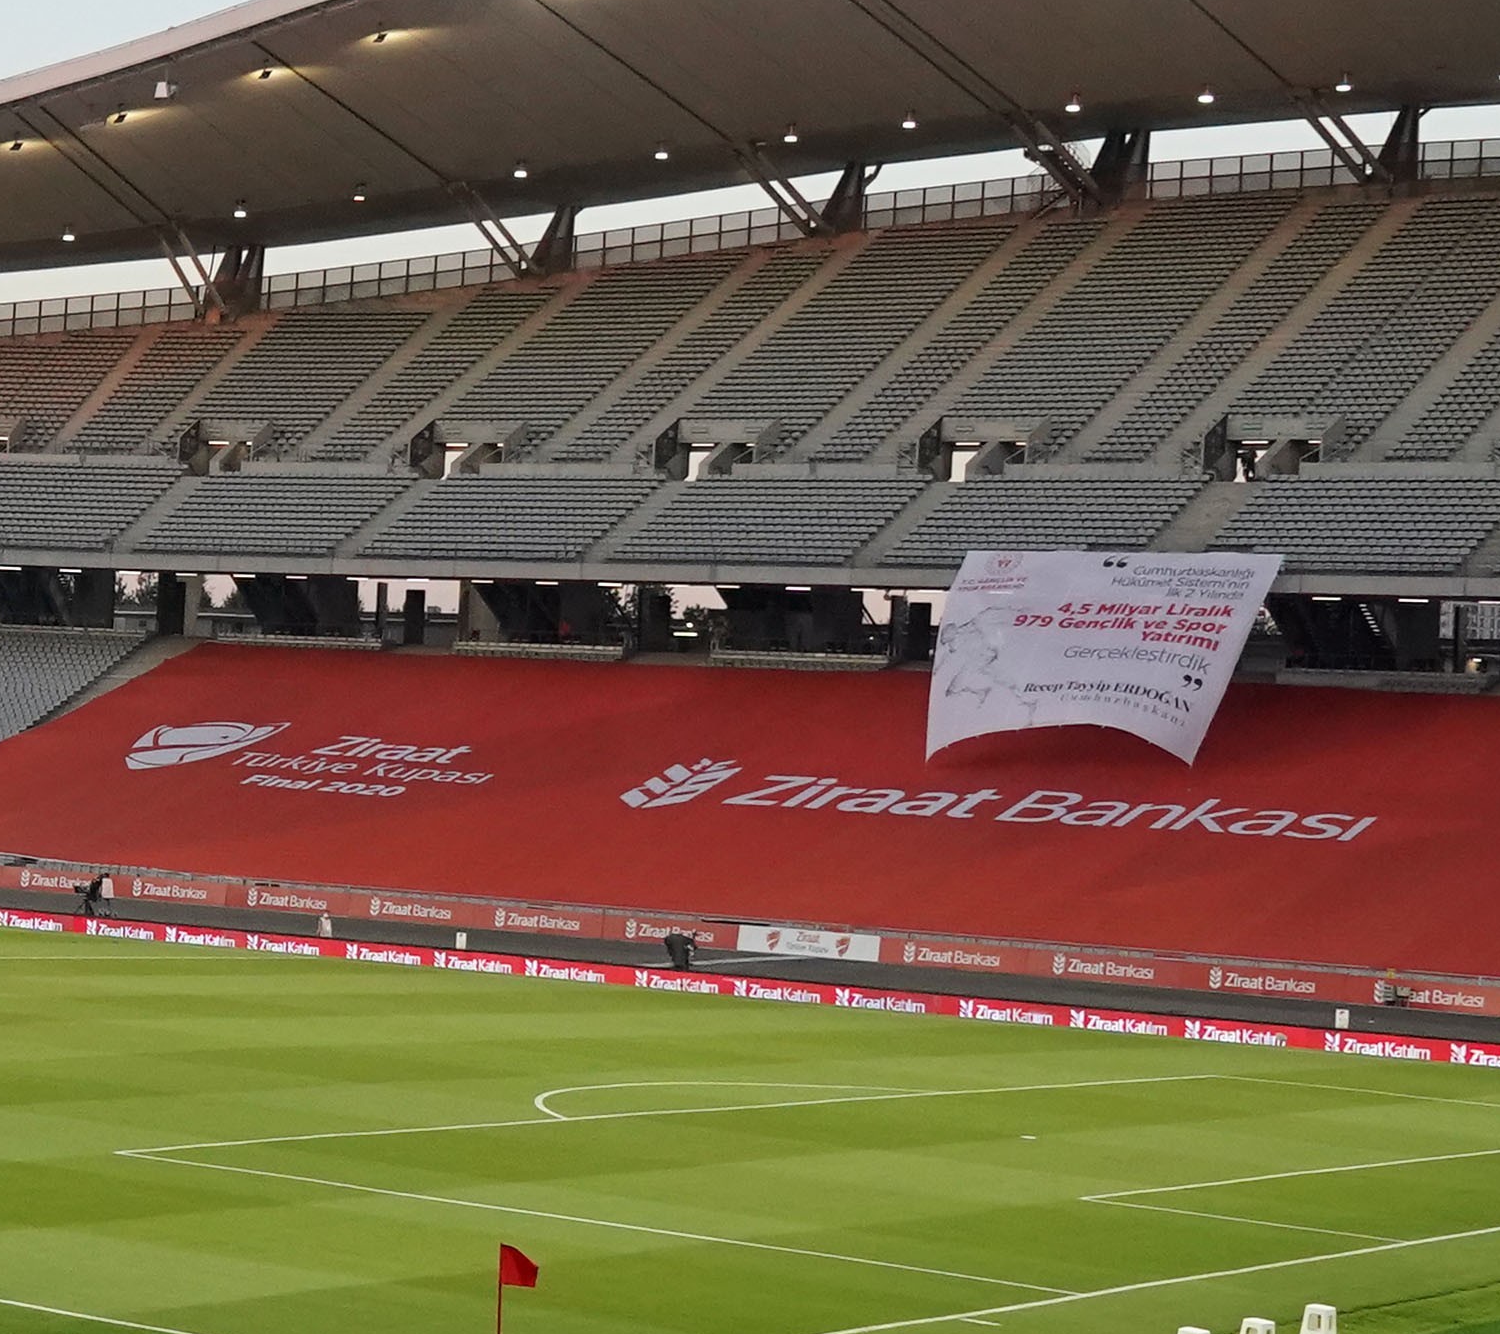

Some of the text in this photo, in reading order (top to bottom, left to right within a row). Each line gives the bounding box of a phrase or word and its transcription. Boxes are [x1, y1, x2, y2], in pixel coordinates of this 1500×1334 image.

[1058, 602, 1235, 618] 4,5 Milyar Liralık
[1012, 615, 1228, 635] 979 Gençlik ve Spor
[1141, 629, 1220, 652] Yatırımı
[1062, 645, 1211, 675] Gerçekleştirdik
[1023, 680, 1193, 714] Recep Tayyip ERDOĞAN
[311, 735, 471, 763] Ziraat
[232, 751, 494, 785] Türkiye Kupası
[240, 775, 406, 797] Final 2020
[722, 774, 1377, 842] Ziraat Bankası
[144, 882, 207, 900] Ziraat Bankası
[260, 892, 327, 911] Ziraat Bankası
[383, 901, 451, 919] Ziraat Bankası
[9, 915, 33, 930] Ziraat
[507, 913, 580, 931] Ziraat Bankası
[359, 949, 421, 965] Ziraat Katılım
[917, 946, 1000, 967] Ziraat Bankası
[539, 964, 605, 983] Ziraat Katılım
[1067, 958, 1154, 980] Ziraat Bankası
[1224, 972, 1315, 993] Ziraat Bankası
[749, 983, 821, 1004] Ziraat Katılım
[850, 993, 925, 1013] Ziraat Katılım
[1343, 1038, 1430, 1060] Ziraat Katılım
